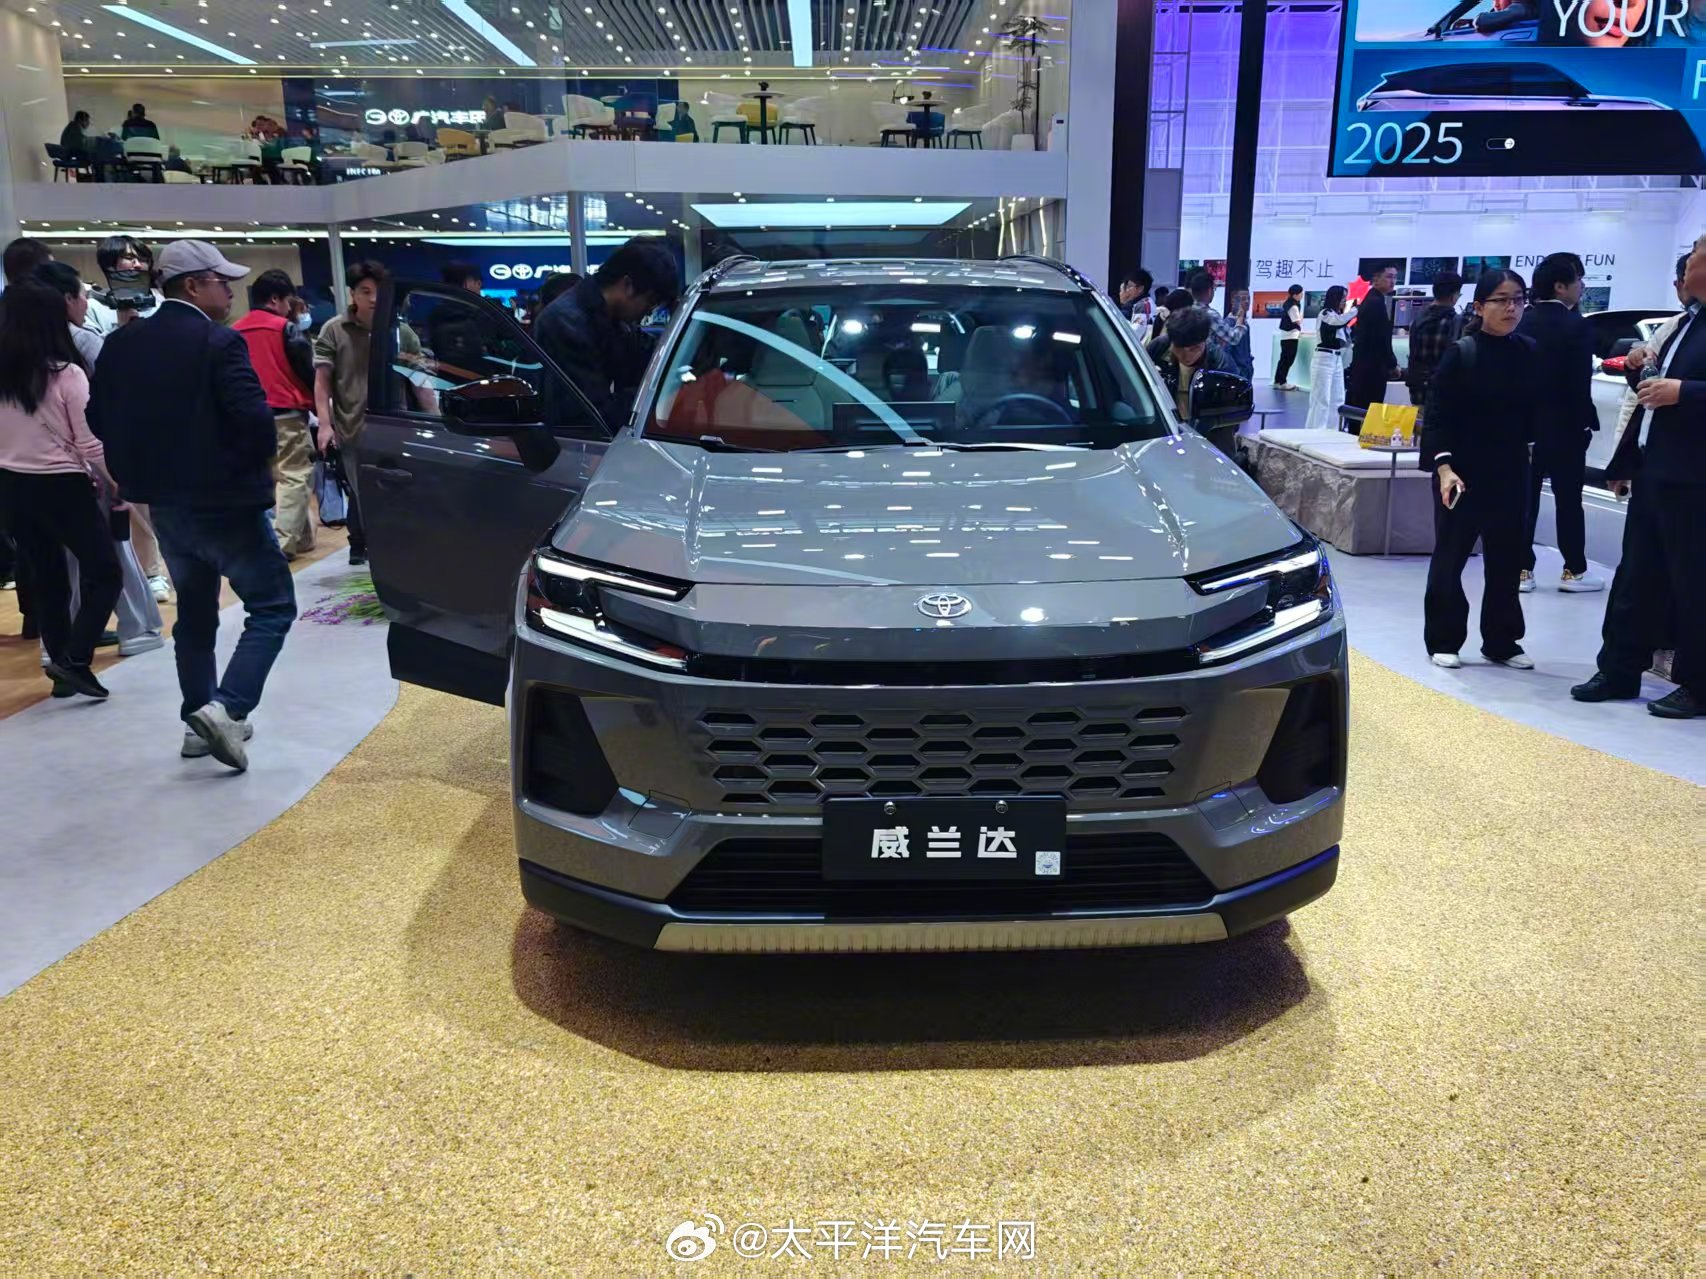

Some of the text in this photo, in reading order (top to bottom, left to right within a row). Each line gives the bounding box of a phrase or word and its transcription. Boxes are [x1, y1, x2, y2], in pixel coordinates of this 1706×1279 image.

[1553, 0, 1688, 38] YOUR
[1344, 121, 1463, 164] 2025
[1255, 258, 1334, 279] 驾趣不止
[1585, 254, 1616, 267] FUN
[870, 826, 1018, 858] 威兰达
